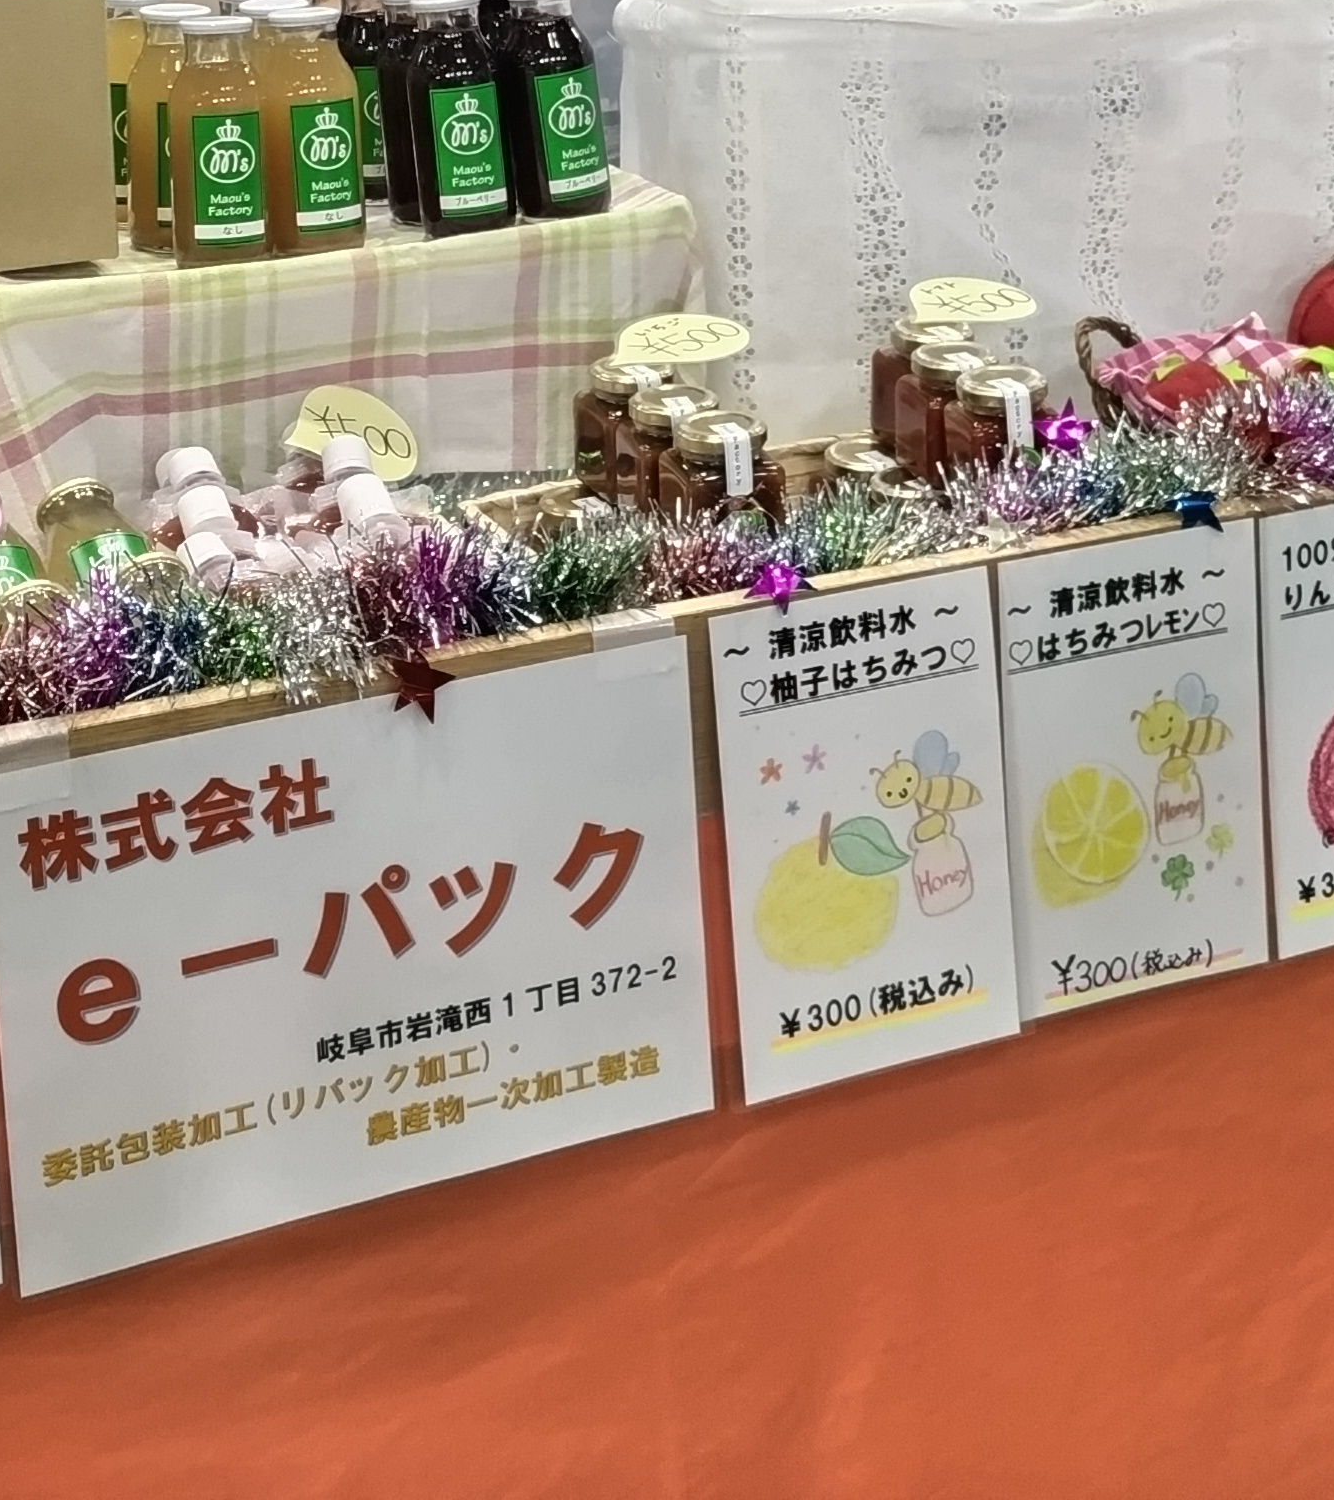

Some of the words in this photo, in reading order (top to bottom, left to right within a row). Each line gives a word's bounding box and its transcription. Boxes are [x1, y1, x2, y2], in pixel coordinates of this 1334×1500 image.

[451, 161, 493, 177] Maou's
[560, 146, 598, 163] Maou's
[560, 155, 602, 174] Factory
[310, 178, 351, 193] Maou's
[450, 173, 496, 189] Factory
[206, 203, 255, 219] Factory
[209, 191, 251, 206] Maou's
[308, 188, 353, 206] Factory
[221, 223, 244, 238] なし
[323, 208, 345, 223] なし
[921, 286, 1032, 318] ¥500
[626, 320, 741, 358] ¥500
[1048, 565, 1187, 620] 清涼飲料水
[767, 604, 918, 660] 清涼飲料水
[1037, 606, 1201, 664] はちみつレモン
[768, 643, 949, 705] 柚子はちみつ
[16, 757, 335, 892] 株式会社
[1157, 796, 1203, 825] Honey
[915, 866, 969, 898] Honey
[1051, 938, 1216, 997] ¥300(税込み)
[778, 963, 975, 1040] ¥300(税込み)
[365, 1043, 663, 1149] 農産物一次加工製造
